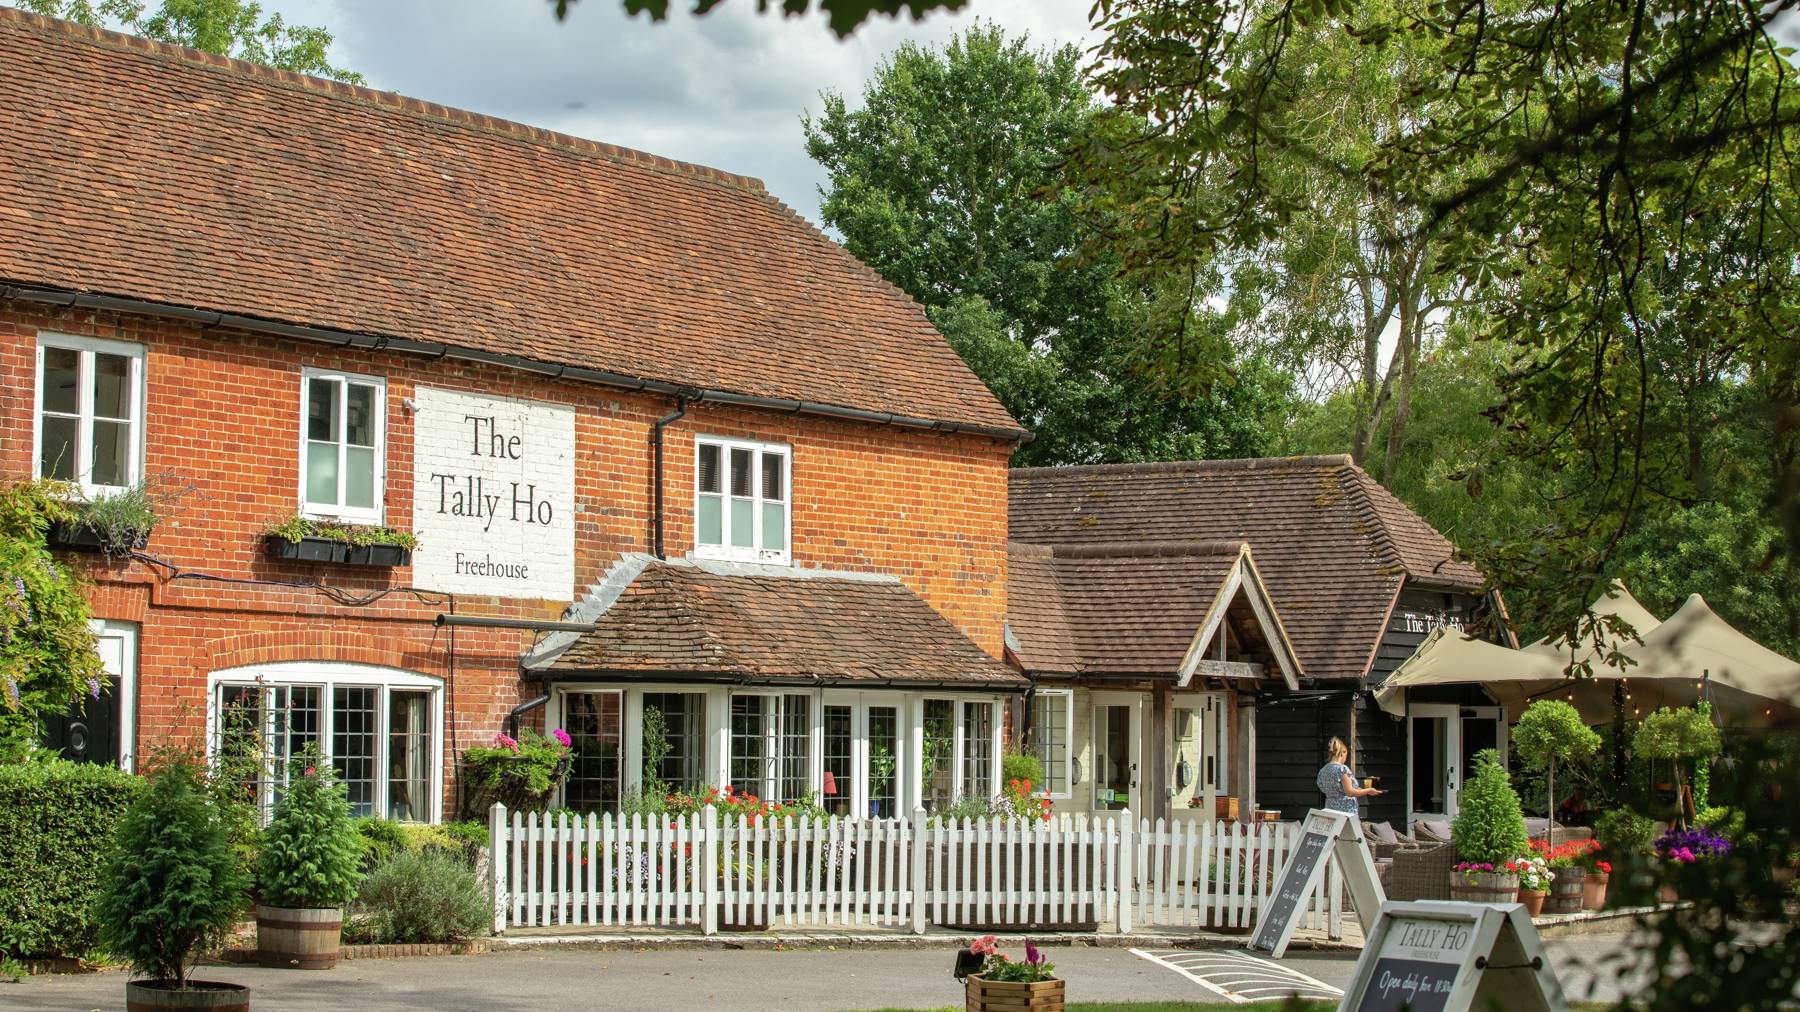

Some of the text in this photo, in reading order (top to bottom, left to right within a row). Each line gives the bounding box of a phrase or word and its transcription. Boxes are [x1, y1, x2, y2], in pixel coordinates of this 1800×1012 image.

[464, 414, 521, 460] The
[430, 472, 553, 532] Tally Ho
[455, 552, 529, 579] Freehouse
[1405, 613, 1424, 632] The
[1450, 616, 1465, 633] Ho
[1399, 921, 1468, 951] TALLY HO
[1379, 970, 1402, 999] Open
[1401, 972, 1419, 1004] daily
